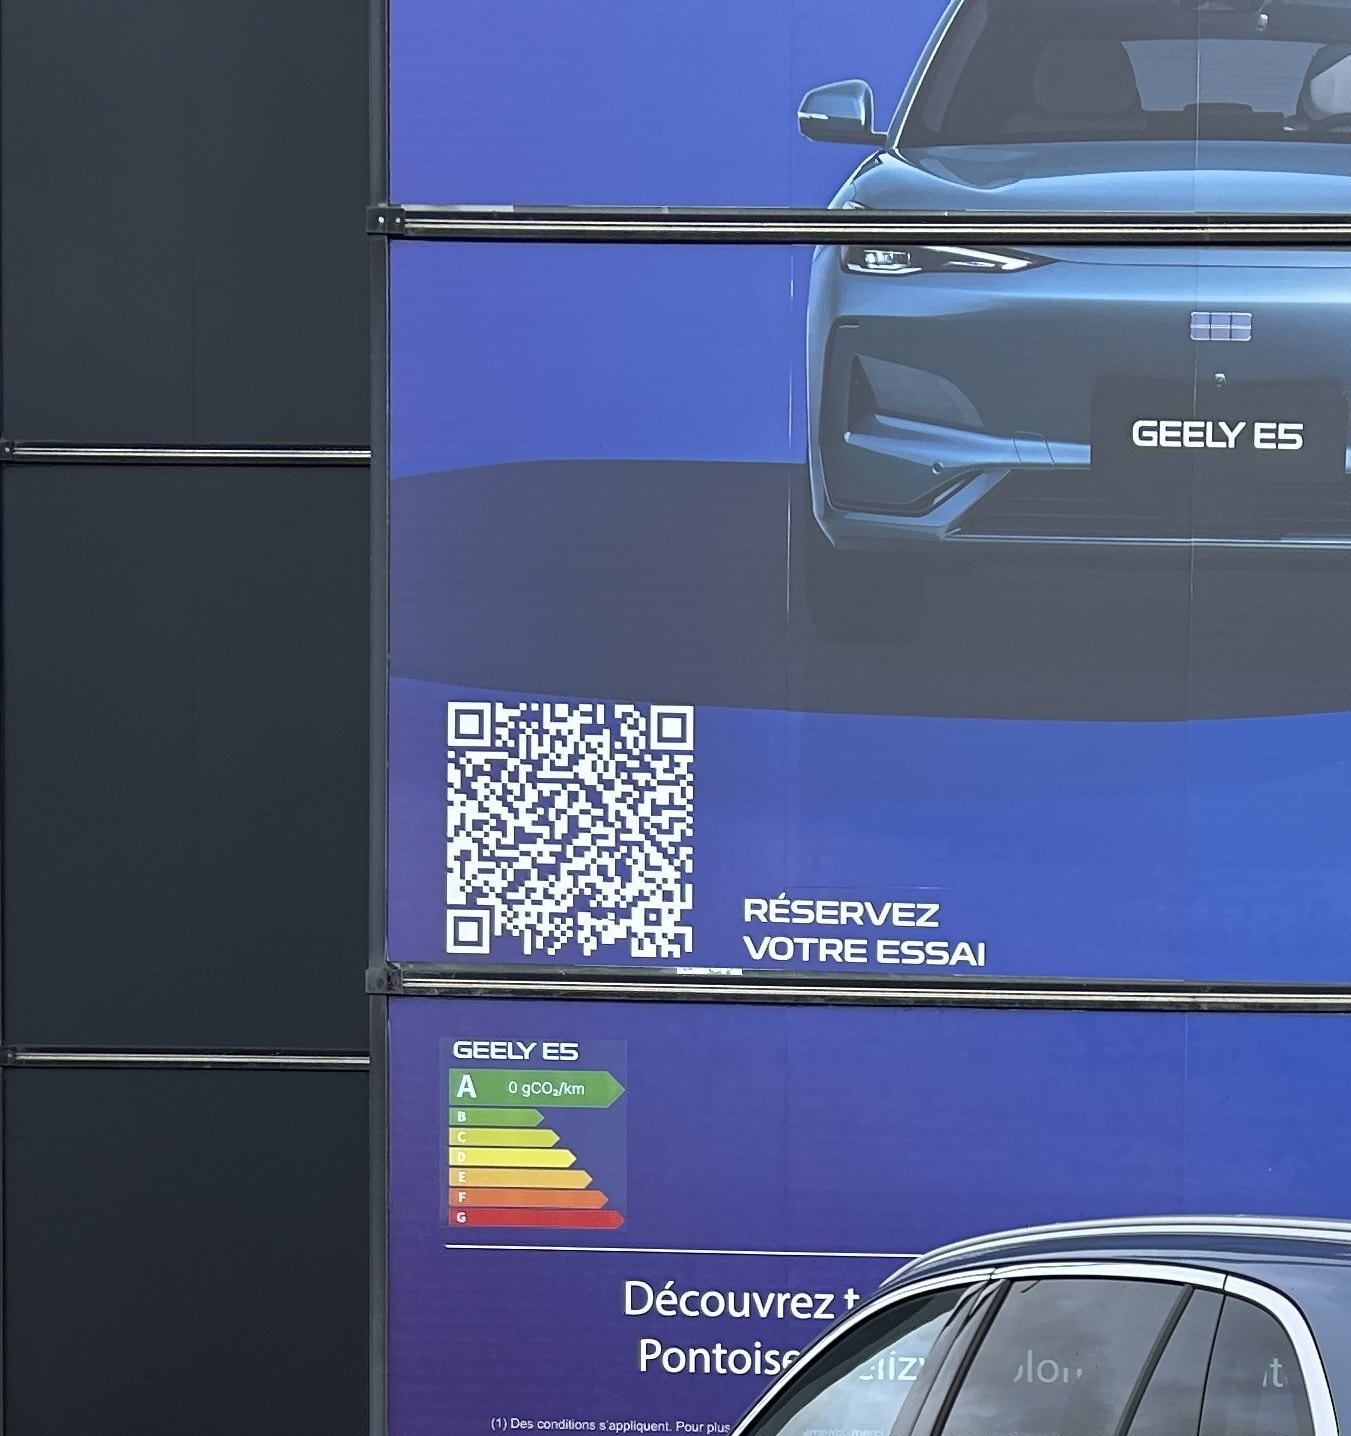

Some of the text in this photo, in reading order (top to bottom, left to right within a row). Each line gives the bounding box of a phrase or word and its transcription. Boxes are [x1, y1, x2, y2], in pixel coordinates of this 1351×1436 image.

[1132, 419, 1304, 450] GEELY E5
[743, 892, 940, 929] RÉSERVEZ
[743, 935, 986, 968] VOTRE ESSAI
[453, 1040, 580, 1062] GEELY E5
[456, 1075, 477, 1099] A
[508, 1081, 518, 1096] 0
[456, 1110, 467, 1123] B
[456, 1131, 467, 1144] C
[456, 1151, 467, 1164] D
[457, 1171, 467, 1184] E
[457, 1191, 467, 1204] F
[456, 1211, 467, 1224] G
[624, 1279, 835, 1320] Découvrez
[490, 1416, 508, 1431] (1)
[510, 1417, 534, 1430] Des
[536, 1418, 596, 1431] conditions
[675, 1420, 704, 1433] Pour
[705, 1421, 731, 1436] plus
